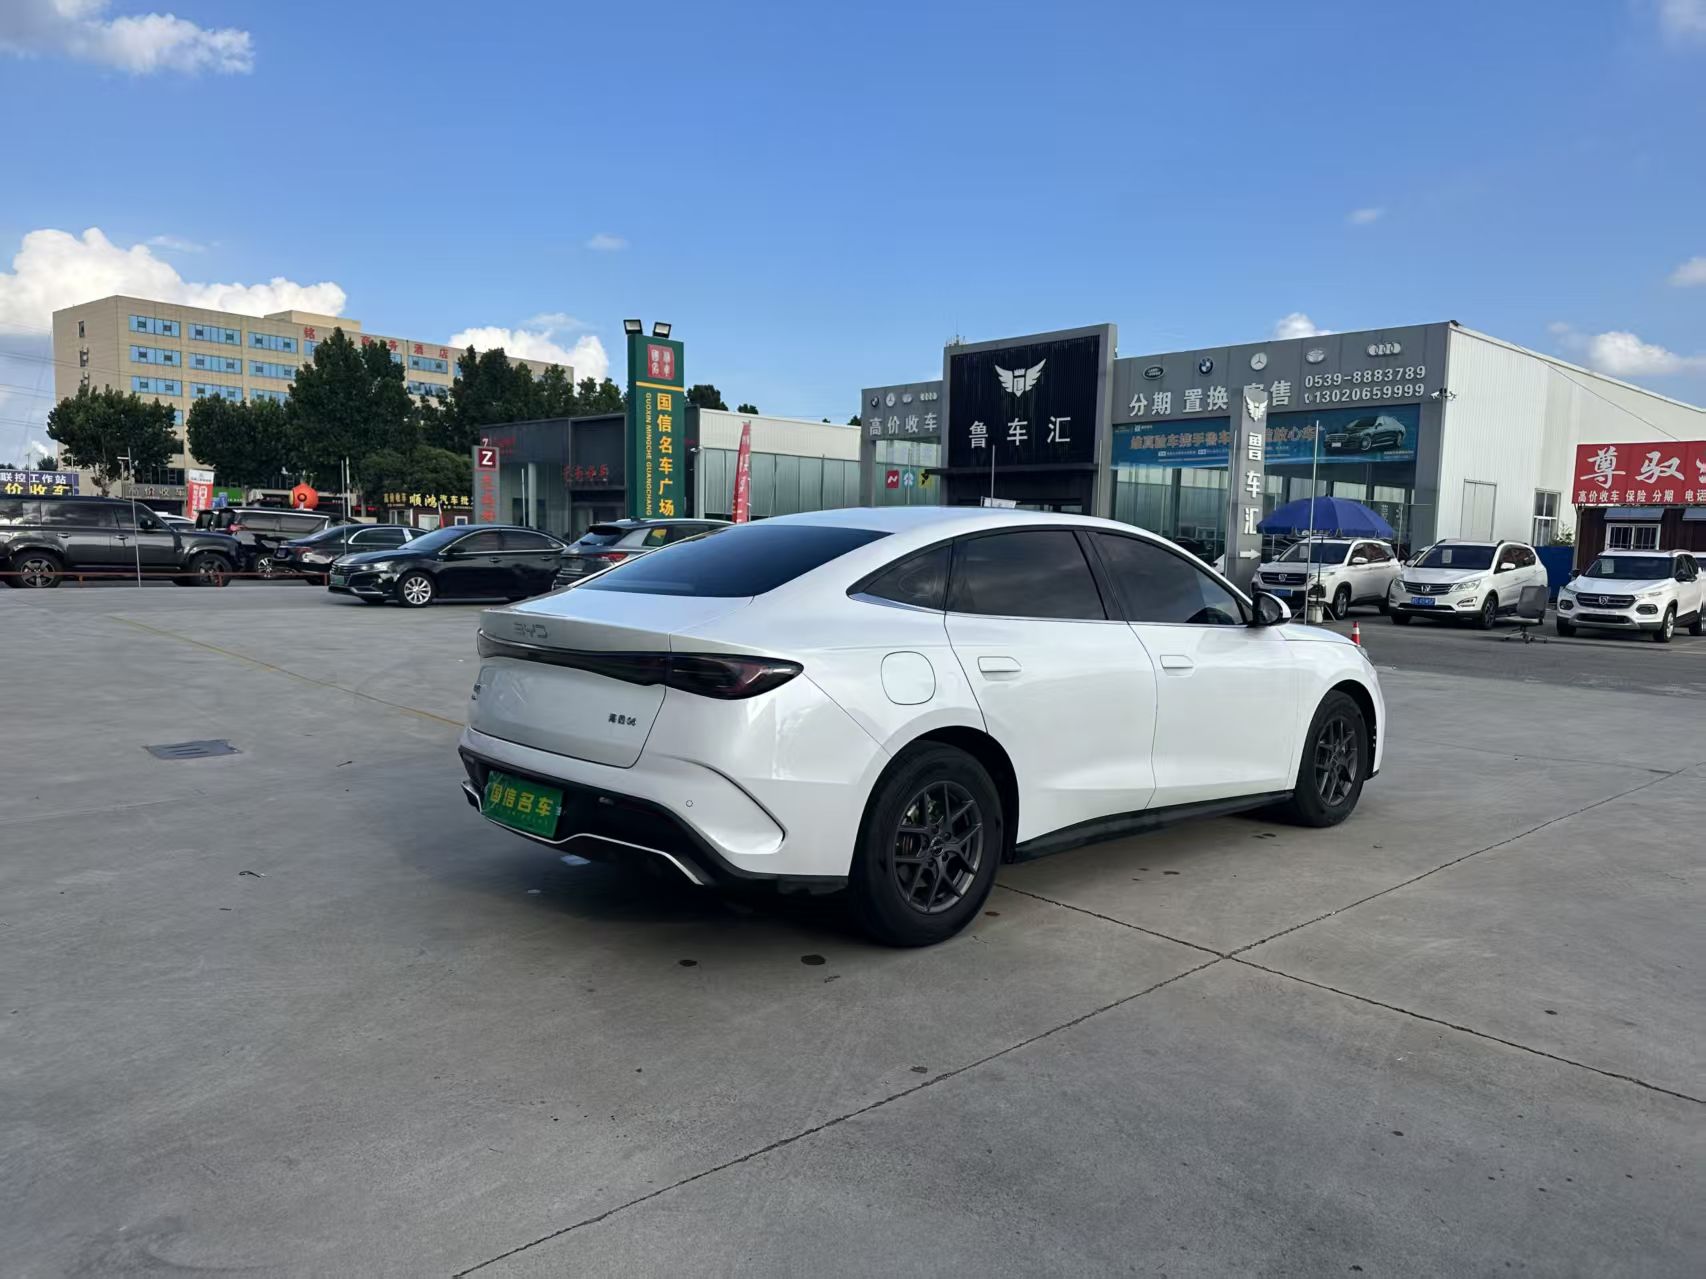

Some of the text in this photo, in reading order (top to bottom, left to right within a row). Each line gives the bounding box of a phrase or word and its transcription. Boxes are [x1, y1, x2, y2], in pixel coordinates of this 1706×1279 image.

[303, 327, 449, 359] 铭商务酒店
[1305, 365, 1426, 388] 0539-8883789
[1129, 391, 1172, 416] 分期
[1182, 385, 1229, 413] 置换
[1315, 383, 1425, 403] 13020659999
[869, 413, 938, 436] 高价收车
[968, 416, 1072, 449] 鲁车汇
[656, 392, 675, 516] 国信名车广场
[1580, 445, 1706, 489] 尊驭
[1244, 432, 1263, 534] 鲁车汇
[1578, 489, 1620, 503] 高价收车
[1625, 489, 1647, 503] 保险
[1652, 489, 1675, 503] 分期
